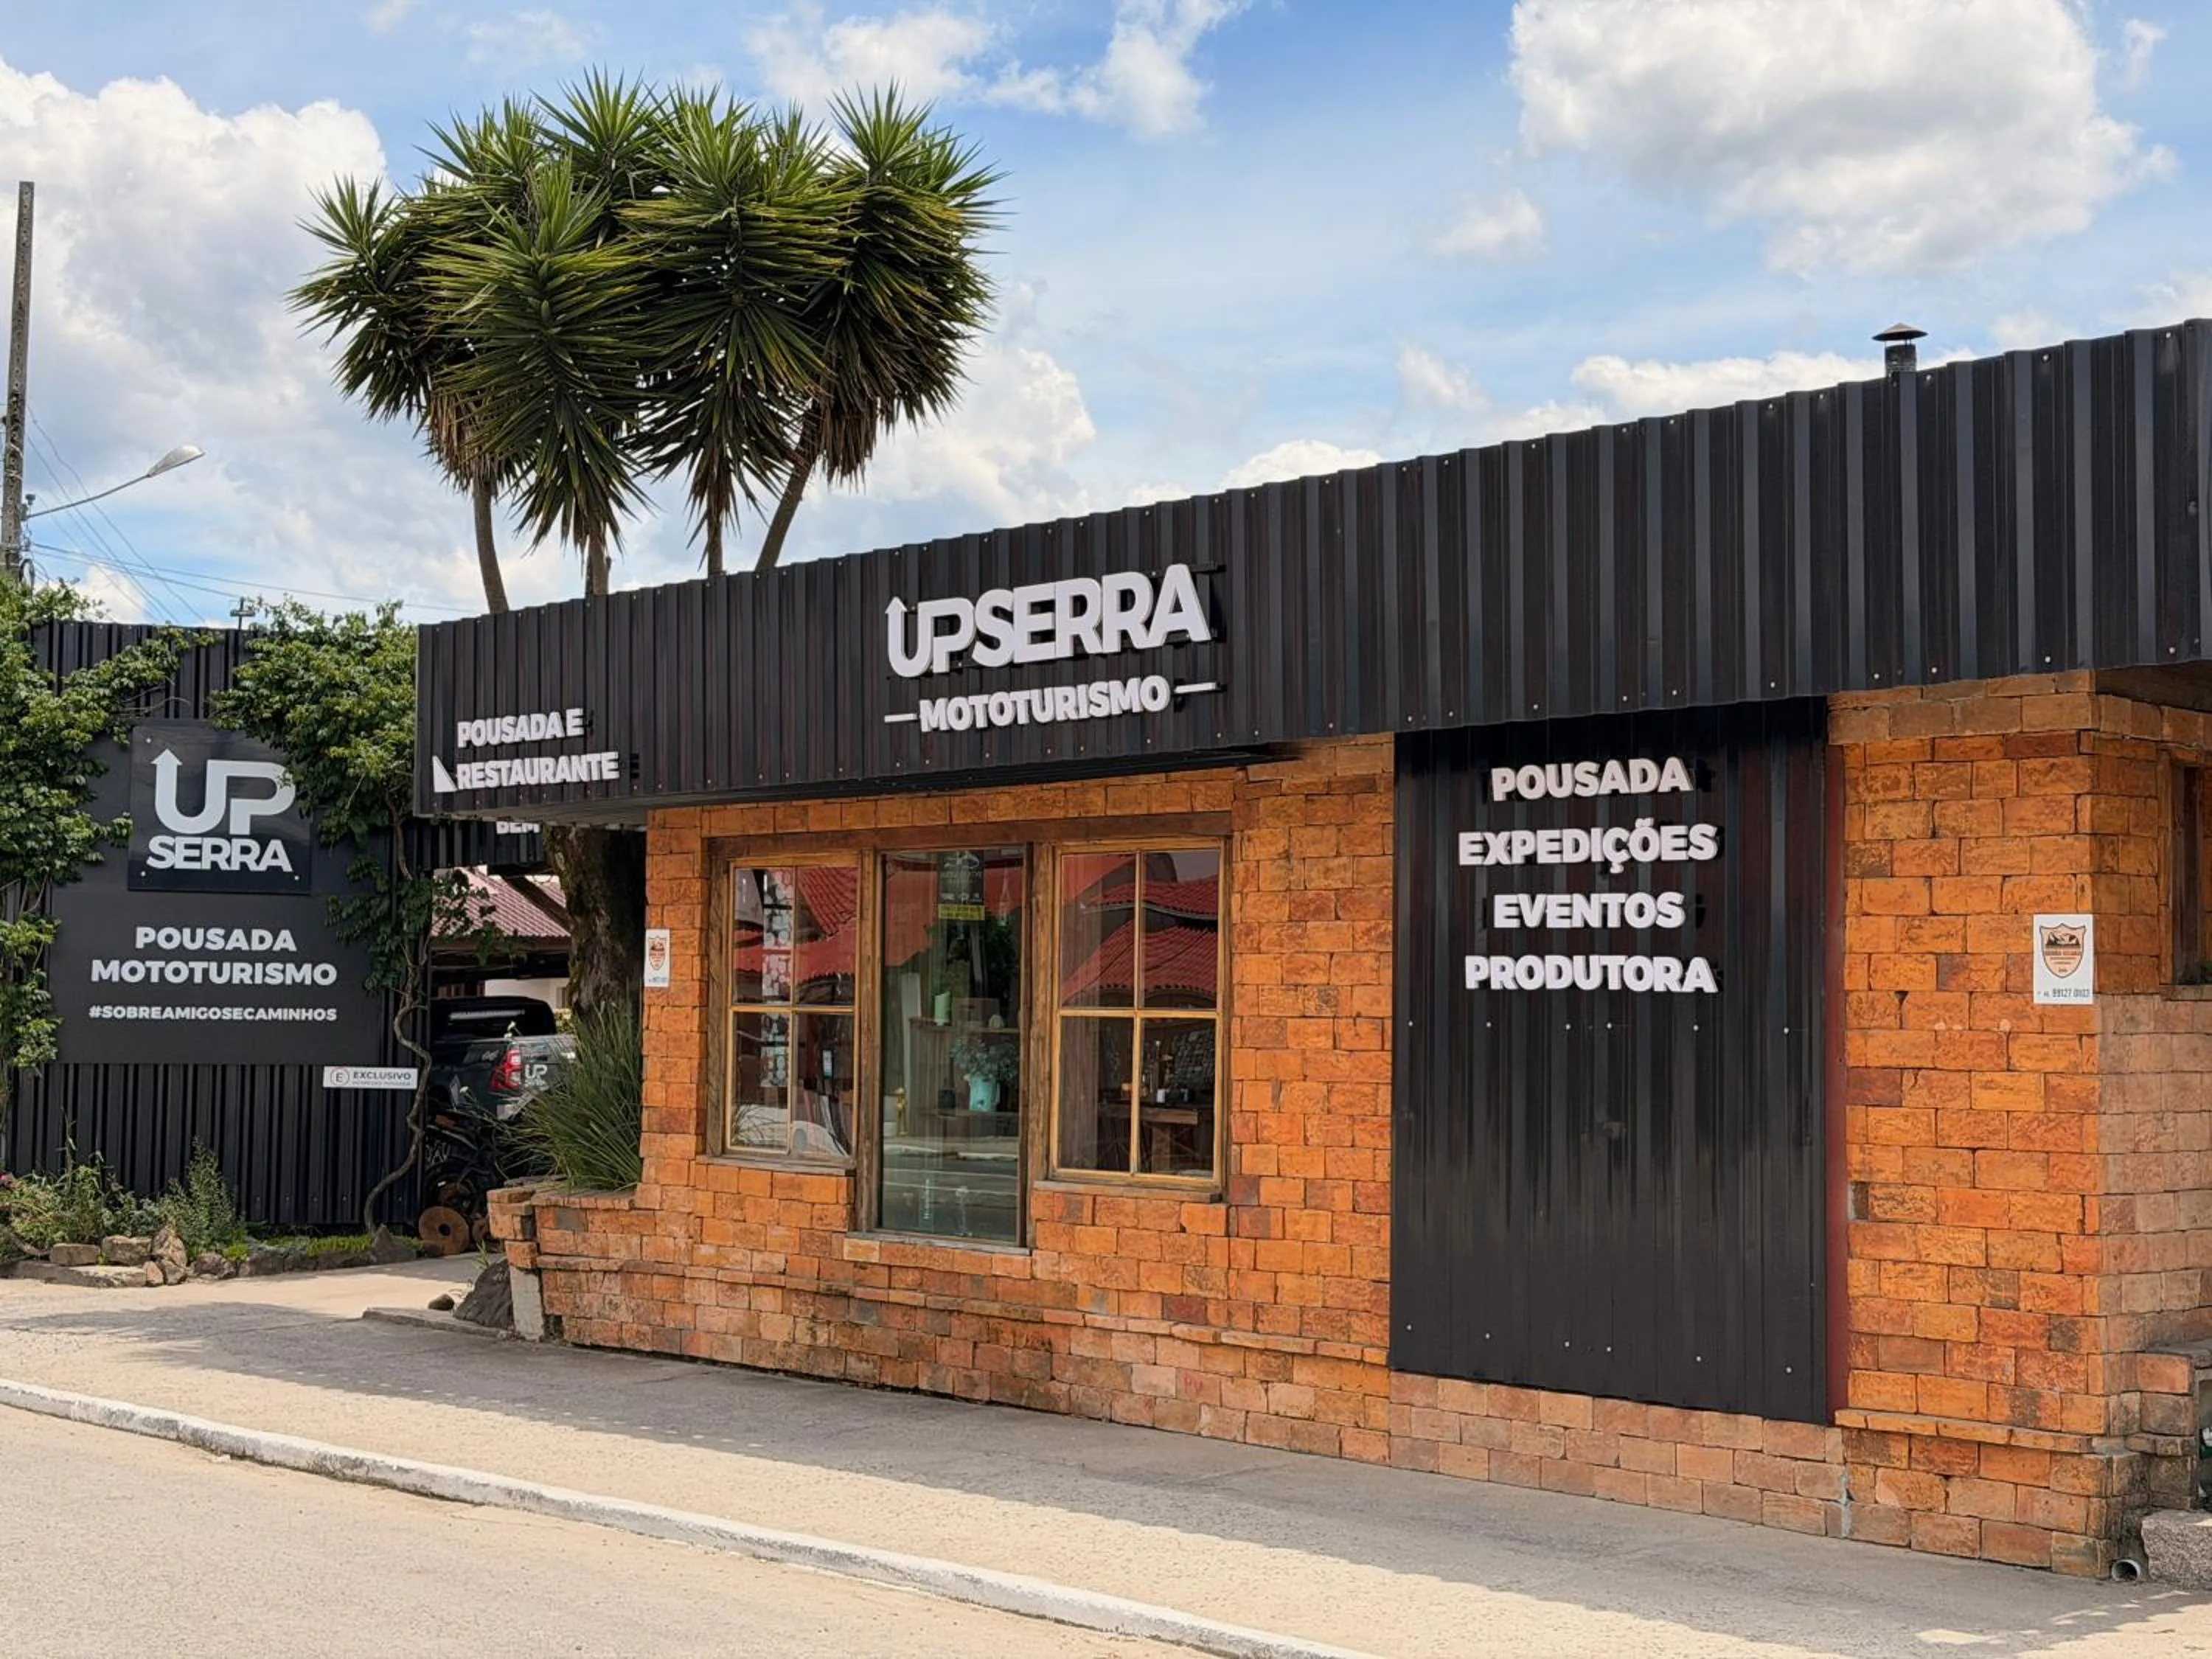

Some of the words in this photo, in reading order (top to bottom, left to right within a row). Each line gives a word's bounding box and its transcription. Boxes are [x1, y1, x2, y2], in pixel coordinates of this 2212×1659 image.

[919, 675, 1171, 732] MOTOTURISMO
[457, 712, 565, 748] POUSADA
[566, 708, 584, 737] E
[456, 751, 619, 790] RESTAURANTE
[1492, 757, 1693, 801] POUSADA
[151, 748, 296, 835] UP
[147, 835, 293, 872] SERRA
[1458, 818, 1718, 874] EXPEDIÇÕES
[1494, 891, 1686, 928] EVENTOS
[135, 926, 297, 951] POUSADA
[91, 959, 337, 986] MOTOTURISMO
[1465, 955, 1718, 993] PRODUTORA
[88, 1005, 337, 1021] #SOBREAMIGOSECAMINHOS
[353, 1071, 411, 1080] EXCLUSIVO
